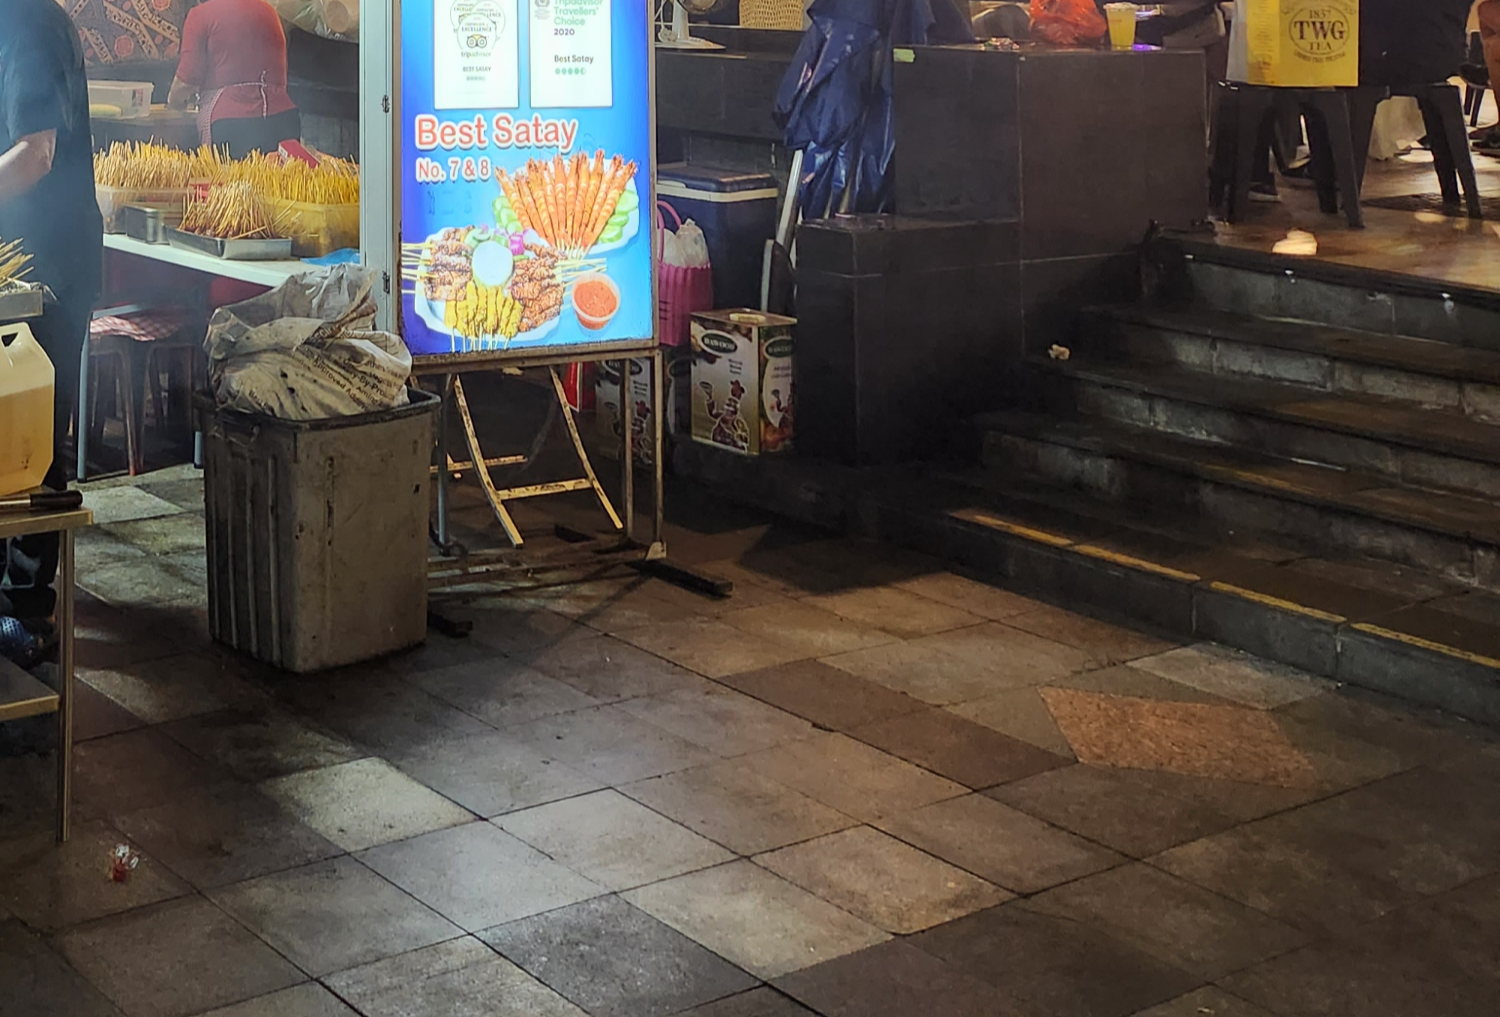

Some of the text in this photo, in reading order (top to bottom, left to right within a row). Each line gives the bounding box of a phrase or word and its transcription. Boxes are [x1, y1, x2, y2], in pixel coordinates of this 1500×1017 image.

[553, 6, 599, 16] Travellers'
[553, 16, 586, 26] Choice
[553, 28, 575, 36] 2020
[1294, 20, 1346, 41] TWG
[1308, 42, 1332, 51] TEA
[461, 51, 491, 59] tripadvisor
[554, 54, 594, 64] Best Satay
[417, 114, 577, 150] Best Satay
[418, 158, 490, 179] No. 7 & 8
[313, 356, 347, 390] Approved
